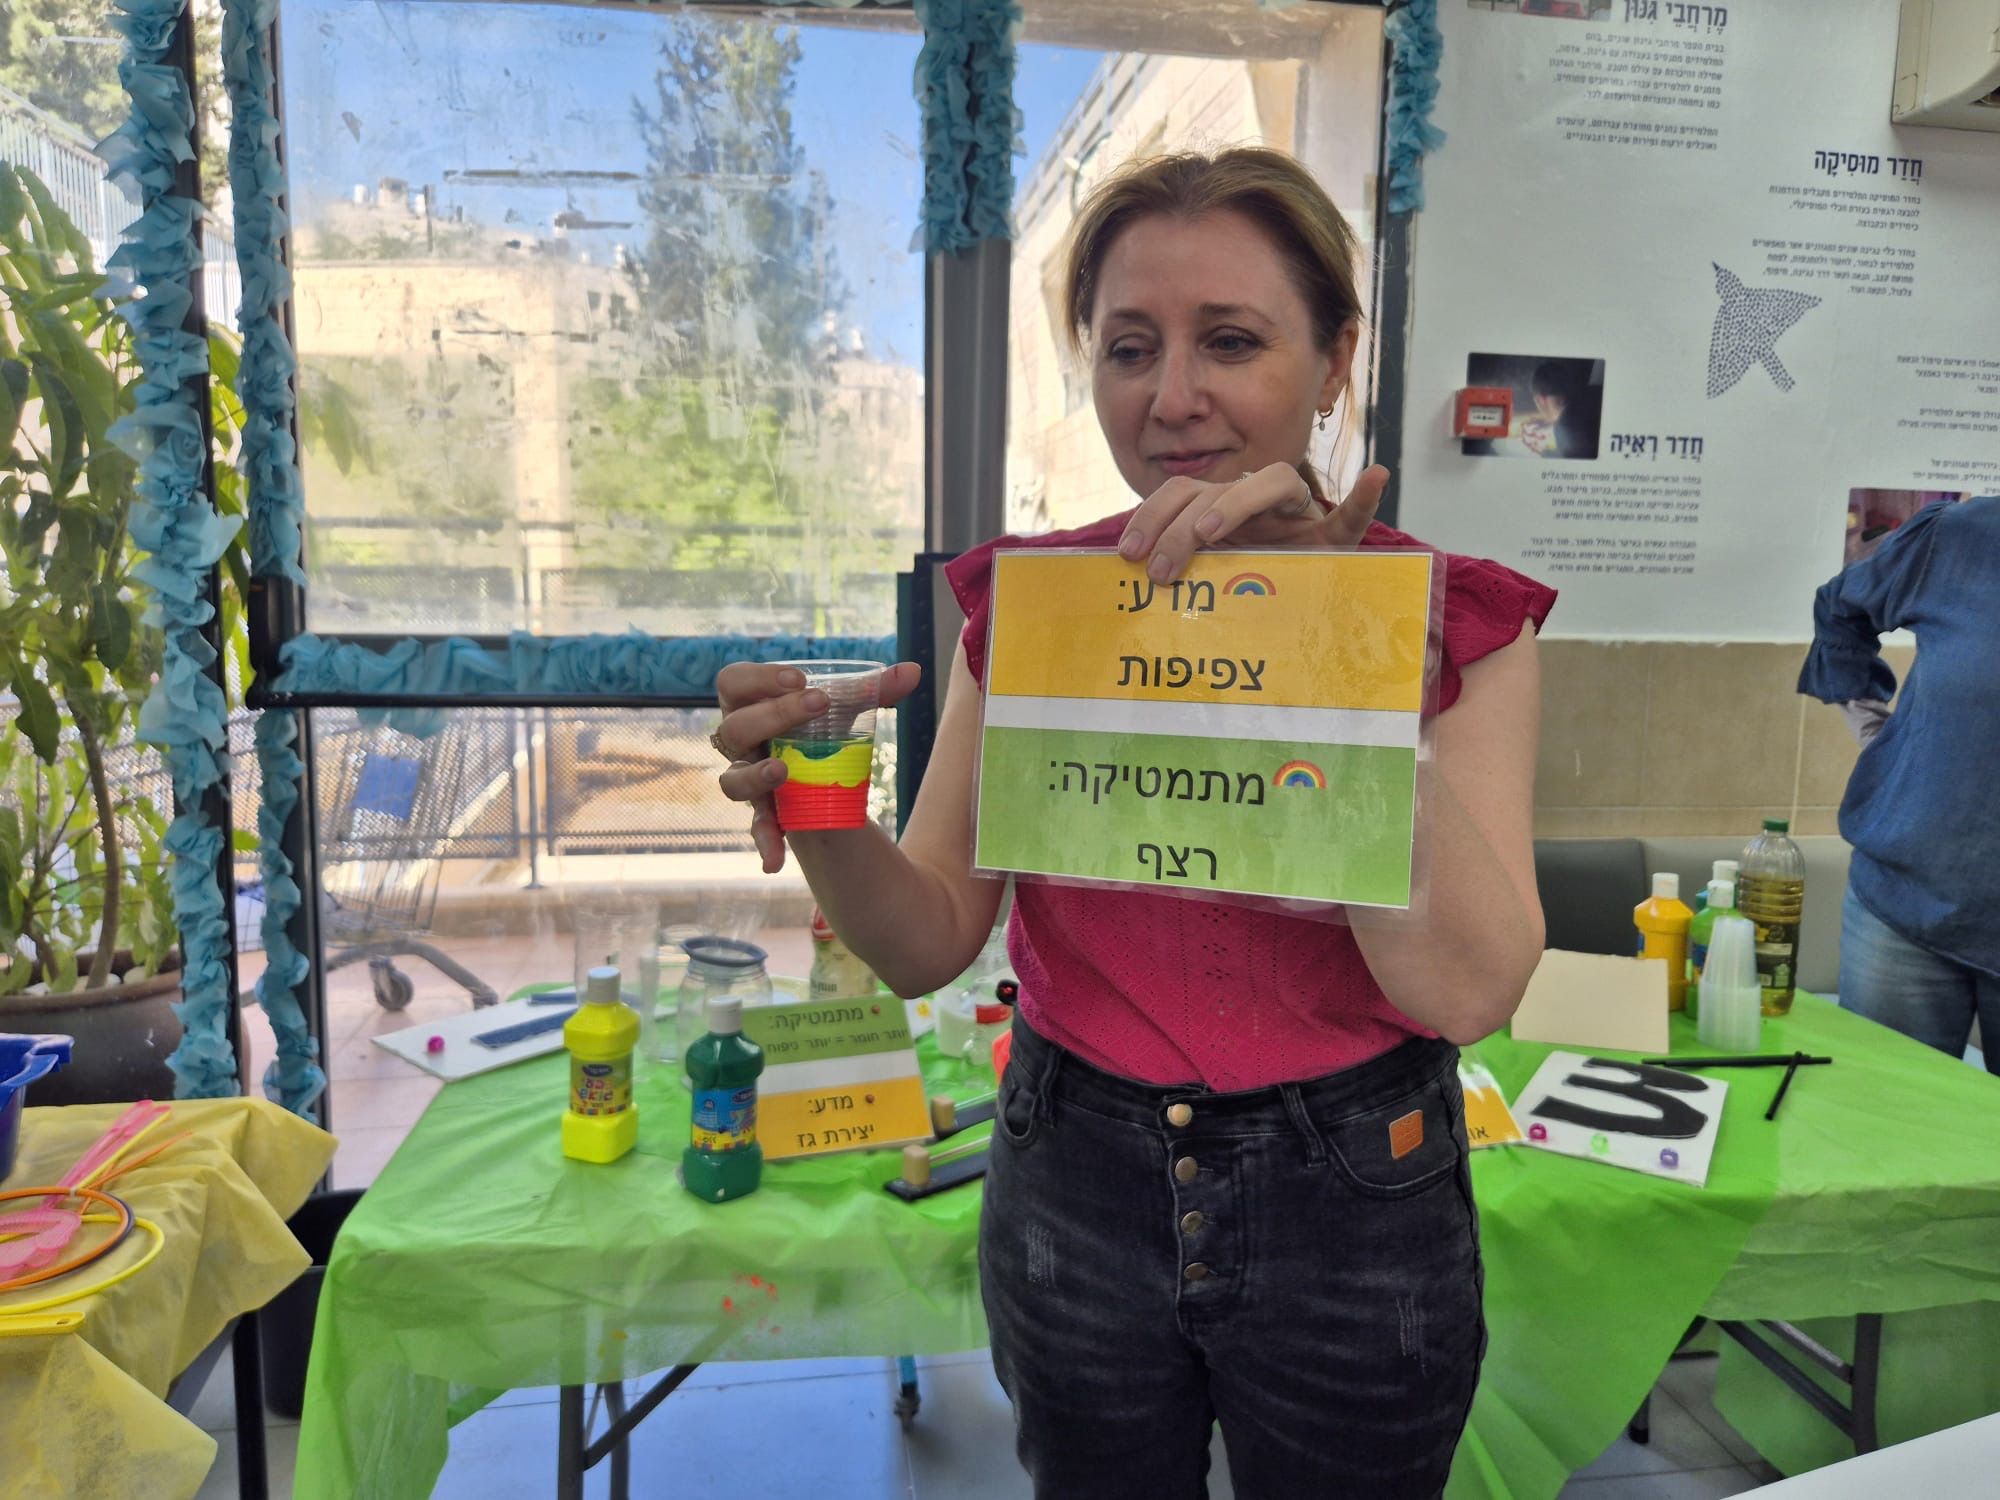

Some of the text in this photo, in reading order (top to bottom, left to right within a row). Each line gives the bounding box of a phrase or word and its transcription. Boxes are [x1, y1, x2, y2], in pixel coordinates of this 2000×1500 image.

[1117, 656, 1266, 691] צפיפות
[1049, 760, 1265, 806] מתמטיקה:
[1137, 843, 1218, 880] רצף
[769, 1007, 864, 1031] מתמטיקה:
[805, 1036, 832, 1047] יותר
[808, 1095, 854, 1114] מדע:
[797, 1124, 875, 1148] יצירת גז
